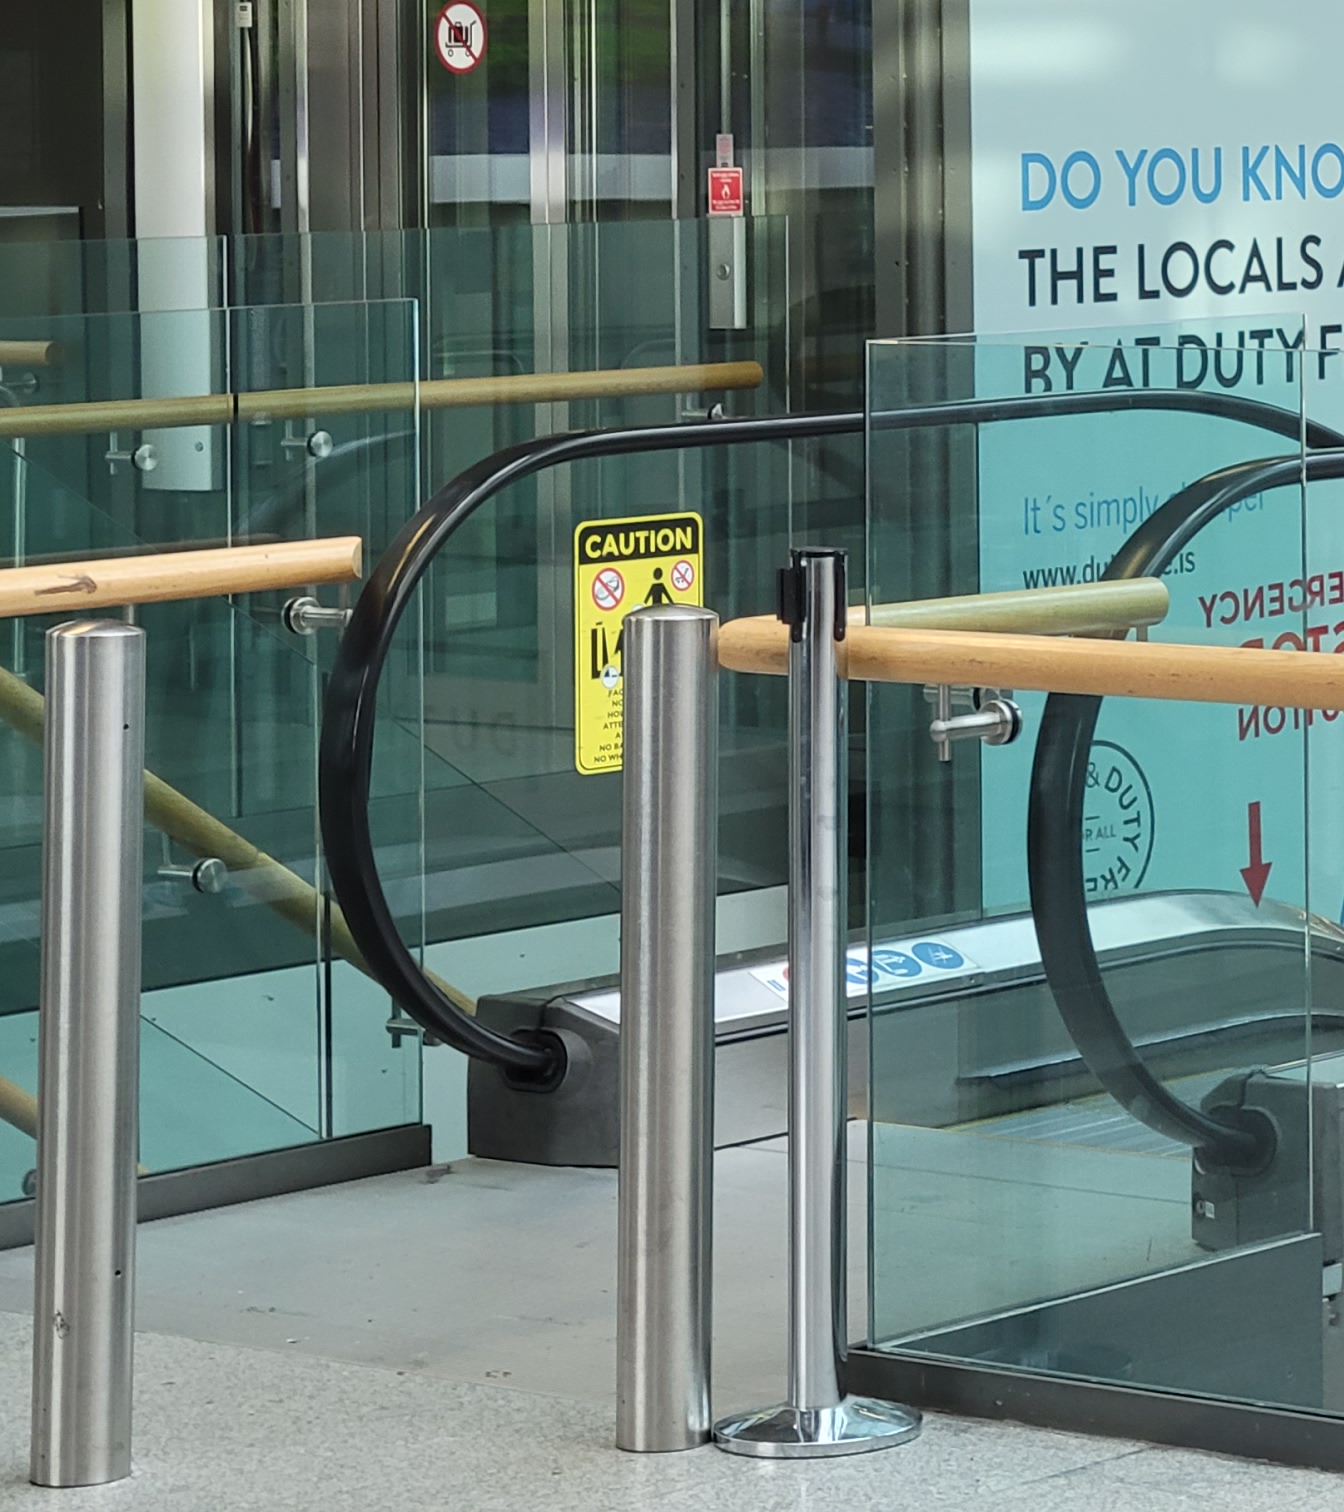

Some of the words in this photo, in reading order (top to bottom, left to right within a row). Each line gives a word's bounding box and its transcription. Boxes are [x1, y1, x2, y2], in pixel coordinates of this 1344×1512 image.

[1020, 150, 1100, 211] DO
[1115, 146, 1222, 207] YOU
[1018, 245, 1118, 307] THE
[1137, 234, 1324, 300] LOCALS
[1023, 339, 1091, 394] BY
[1102, 337, 1162, 389] AT
[1176, 326, 1304, 389] DUTY
[585, 526, 692, 559] CAUTION
[608, 710, 622, 718] HO
[1104, 766, 1141, 853] DUTY
